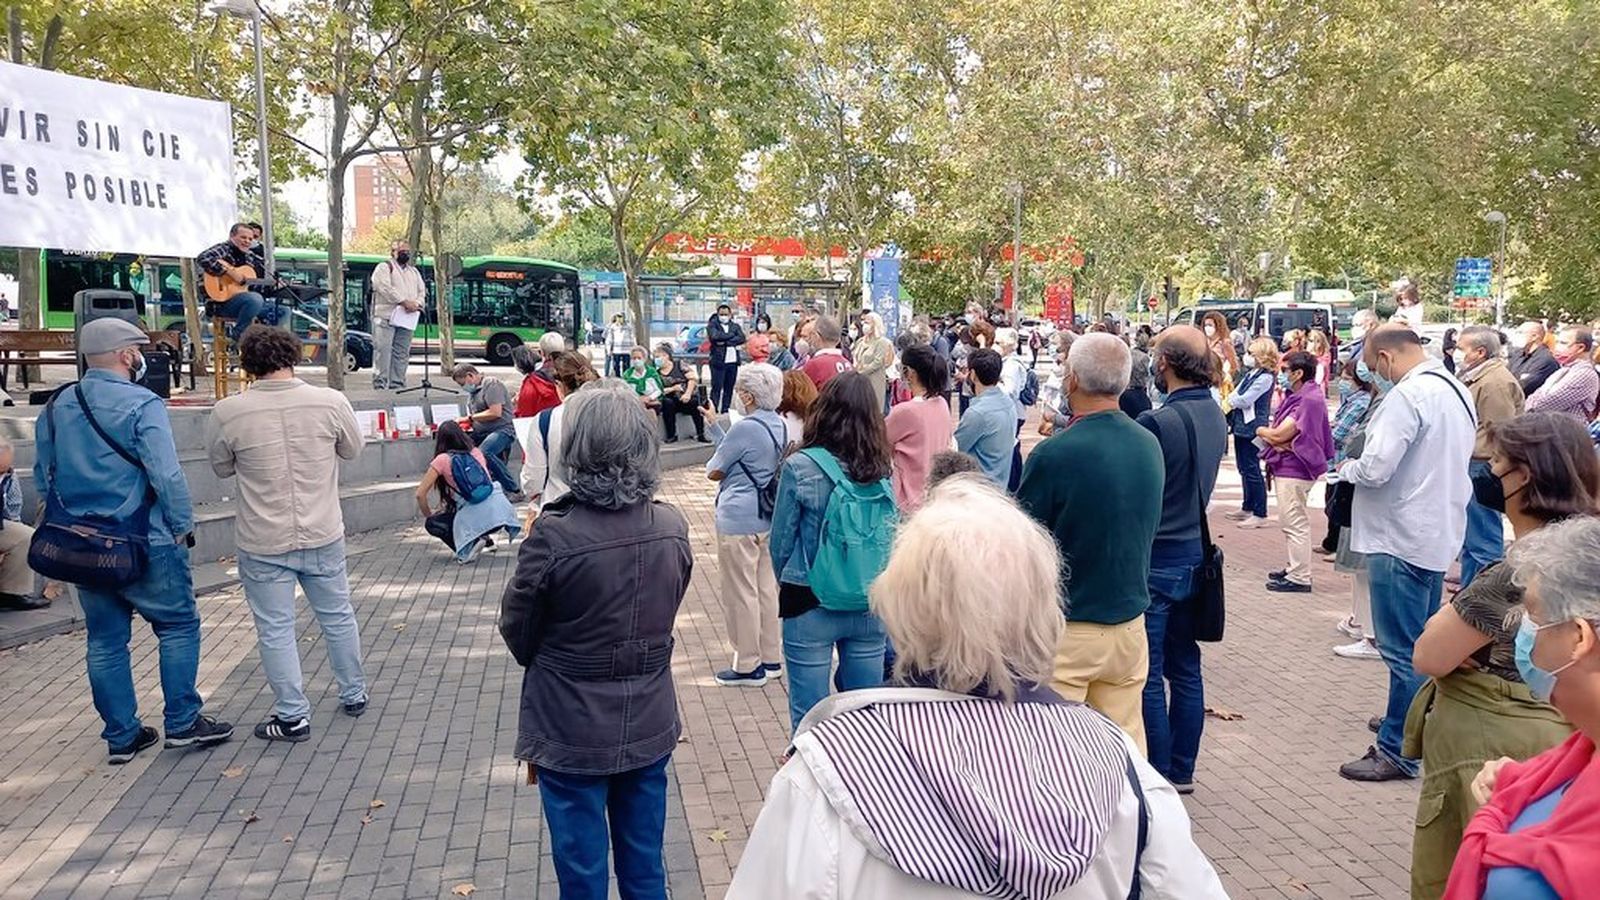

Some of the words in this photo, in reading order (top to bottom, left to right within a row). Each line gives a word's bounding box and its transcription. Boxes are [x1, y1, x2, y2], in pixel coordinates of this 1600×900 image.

[77, 119, 120, 152] SIN
[142, 129, 181, 160] CIE
[1, 163, 38, 196] ES
[65, 171, 168, 209] POSIBLE
